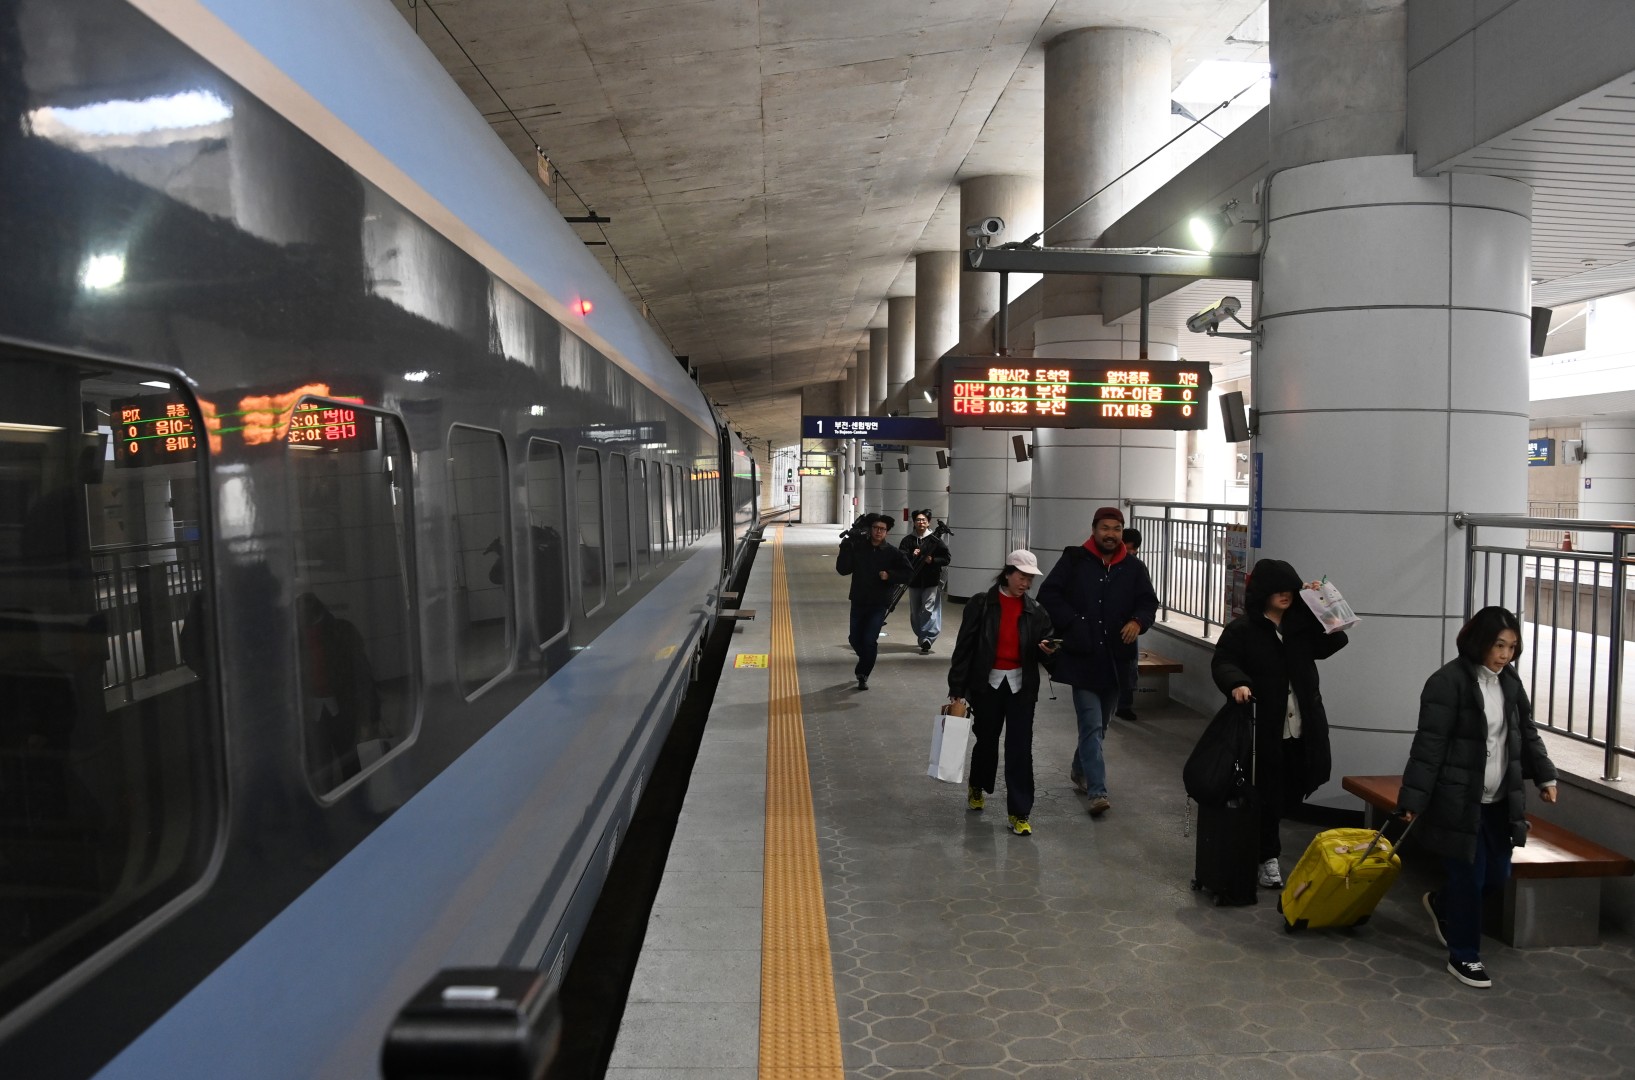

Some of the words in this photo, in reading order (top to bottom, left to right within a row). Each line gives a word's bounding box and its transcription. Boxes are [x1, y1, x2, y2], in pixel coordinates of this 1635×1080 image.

[988, 368, 1030, 382] 출발시간
[1036, 369, 1070, 383] 도착역
[1107, 371, 1150, 384] 열차종류
[1178, 372, 1198, 386] 지연
[954, 383, 985, 398] 이번
[989, 386, 1027, 399] 10:21
[1036, 385, 1067, 400] 부전
[1101, 387, 1162, 401] KTX-이음
[1182, 389, 1191, 401] 0
[954, 399, 985, 414] 다음
[989, 401, 1028, 414] 10:32
[1036, 401, 1066, 415] 부전
[1102, 404, 1123, 417] ITX
[1127, 404, 1153, 418] 마음
[1182, 405, 1191, 417] 0
[816, 420, 823, 434] 1
